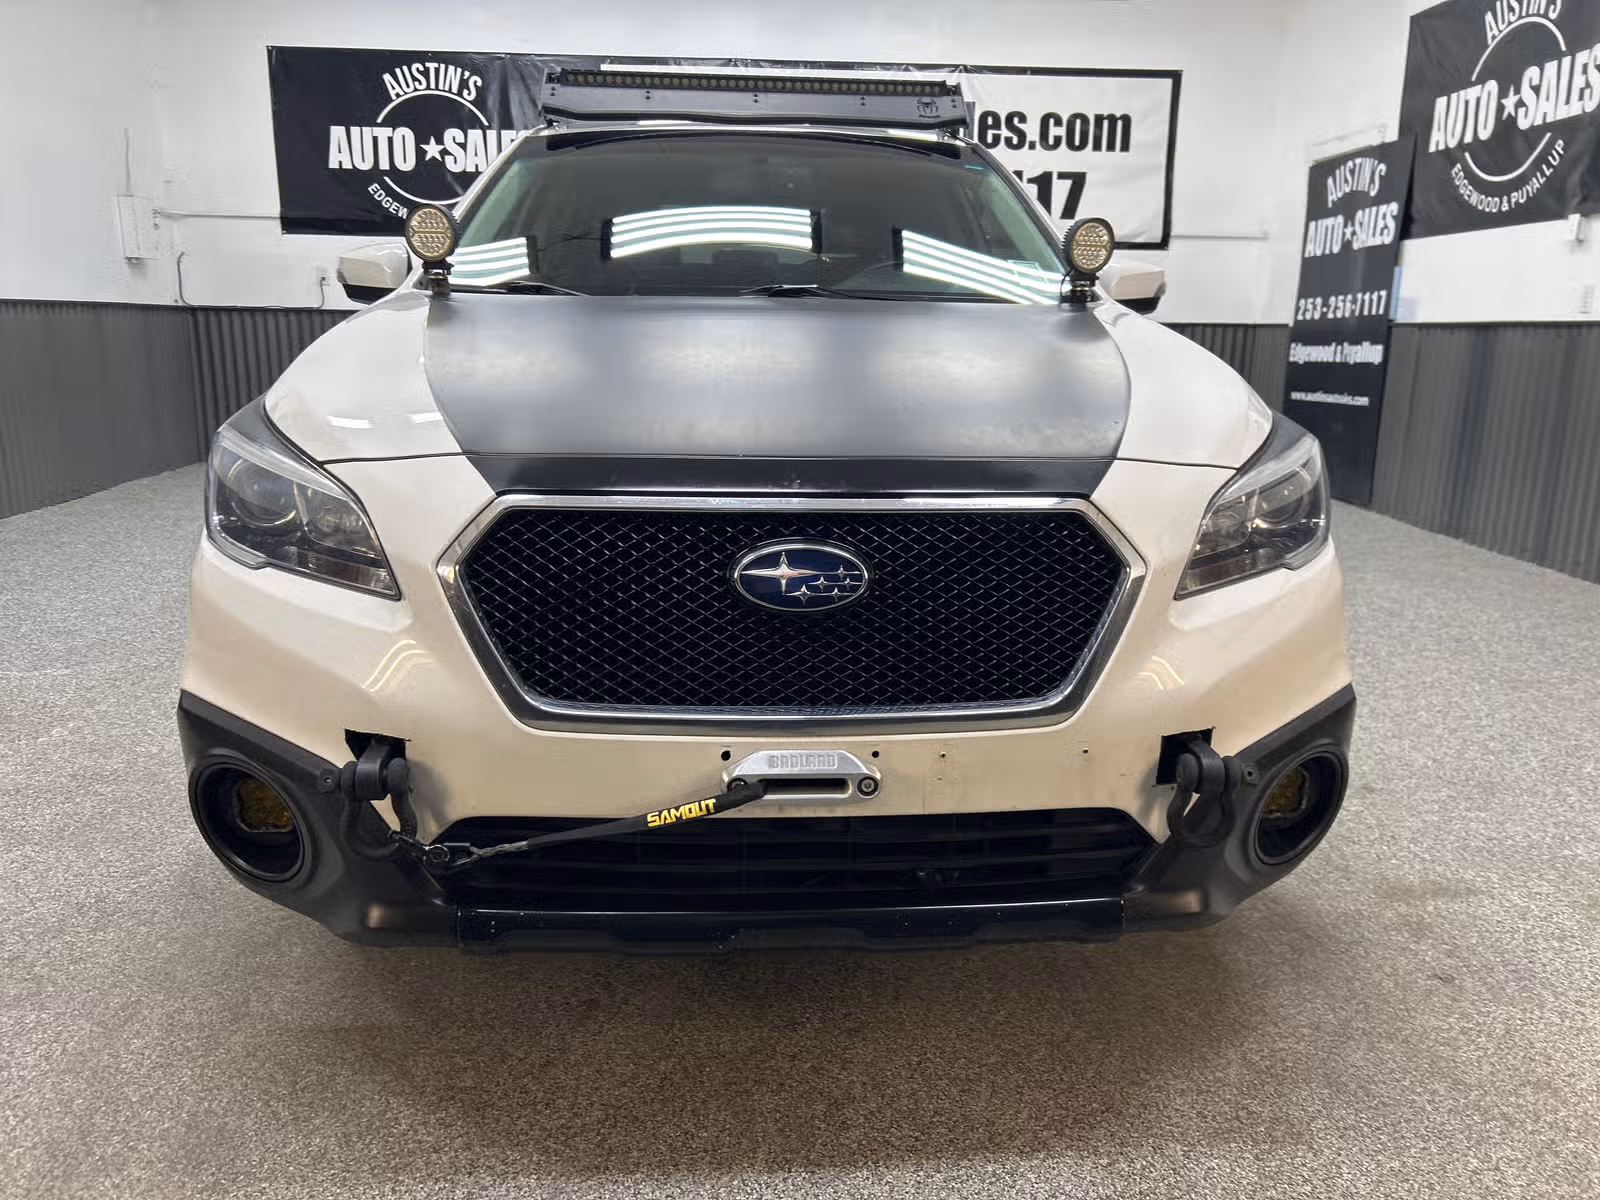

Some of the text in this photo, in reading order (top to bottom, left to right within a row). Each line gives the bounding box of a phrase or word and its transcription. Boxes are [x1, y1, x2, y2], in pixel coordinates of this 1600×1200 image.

[382, 62, 482, 101] AUSTIN'S
[1428, 42, 1600, 152] AUTO SALES
[328, 126, 529, 172] AUTO SAL
[1327, 157, 1387, 208] AUSTIN'S
[1451, 139, 1565, 212] EDGEWOOD & PUYALLUP
[1304, 201, 1399, 258] AUTO SALES
[1297, 289, 1387, 321] 253-256-7117
[767, 754, 838, 769] BADLAND
[647, 798, 716, 827] SAMOUT
